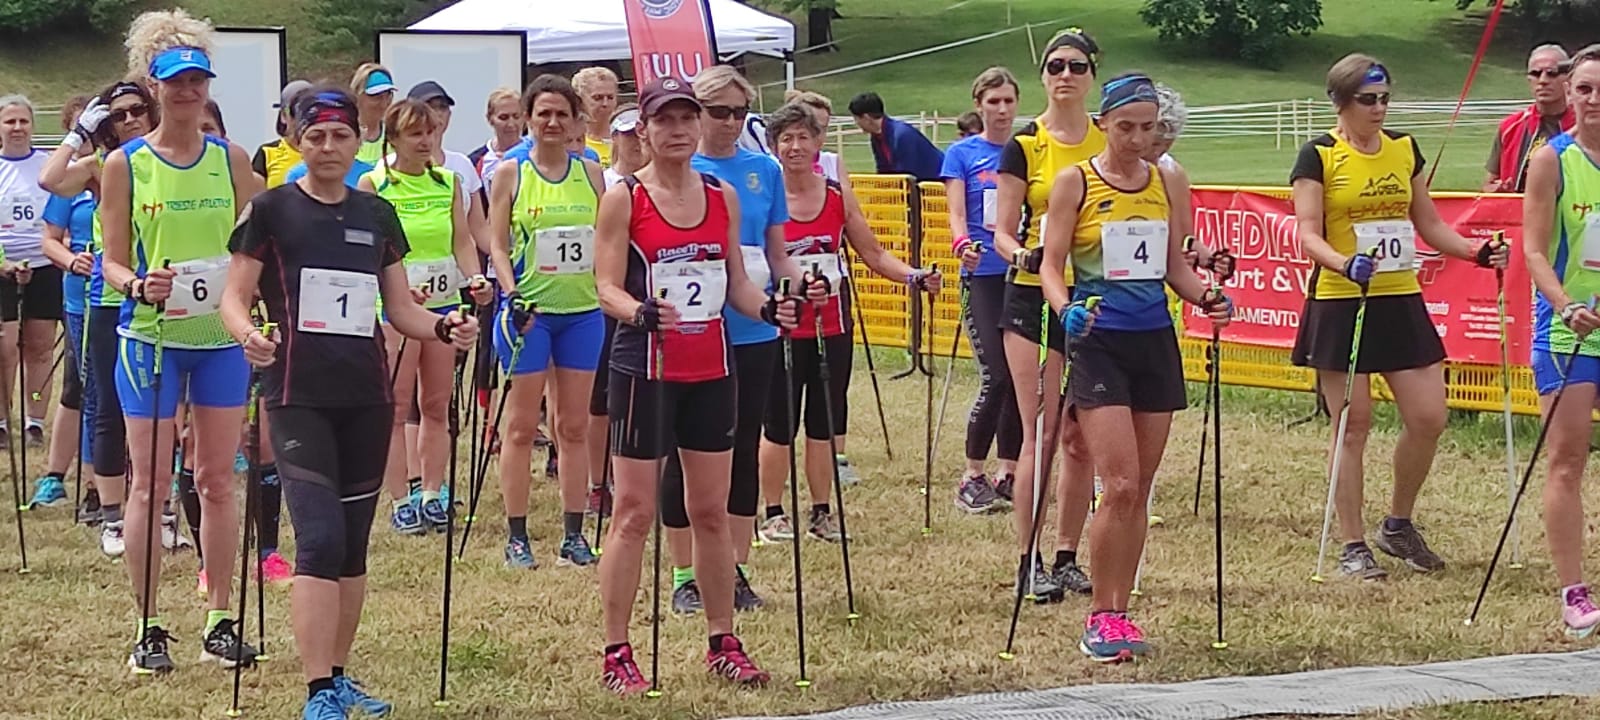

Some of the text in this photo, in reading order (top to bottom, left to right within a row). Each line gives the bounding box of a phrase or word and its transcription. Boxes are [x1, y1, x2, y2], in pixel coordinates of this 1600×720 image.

[13, 205, 34, 221] 56
[557, 242, 583, 262] 13
[1133, 240, 1150, 265] 4
[192, 278, 208, 302] 6
[426, 274, 448, 293] 18
[1271, 266, 1293, 292] &
[336, 292, 348, 318] 1
[686, 282, 702, 306] 2
